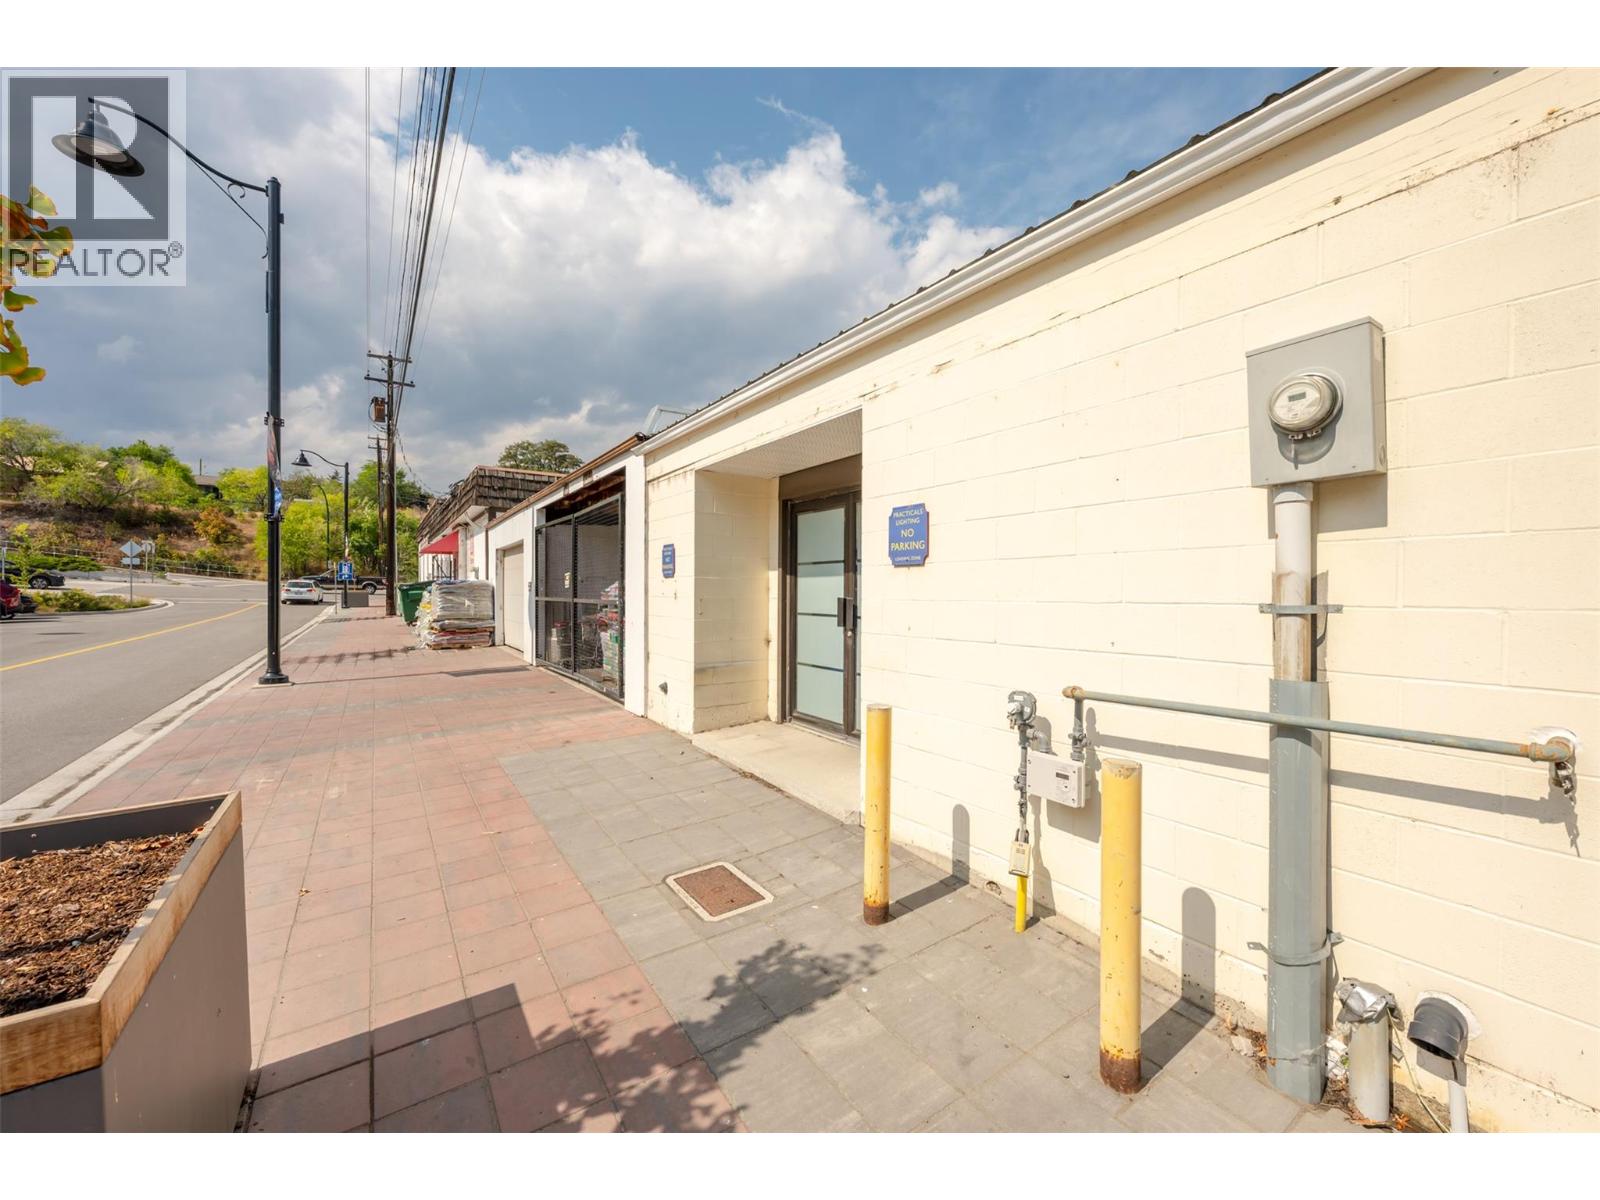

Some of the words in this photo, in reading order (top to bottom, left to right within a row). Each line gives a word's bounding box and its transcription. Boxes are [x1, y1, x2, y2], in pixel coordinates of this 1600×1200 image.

[896, 517, 920, 526] LIGHTING
[901, 528, 914, 537] NO
[891, 540, 925, 551] PARKING
